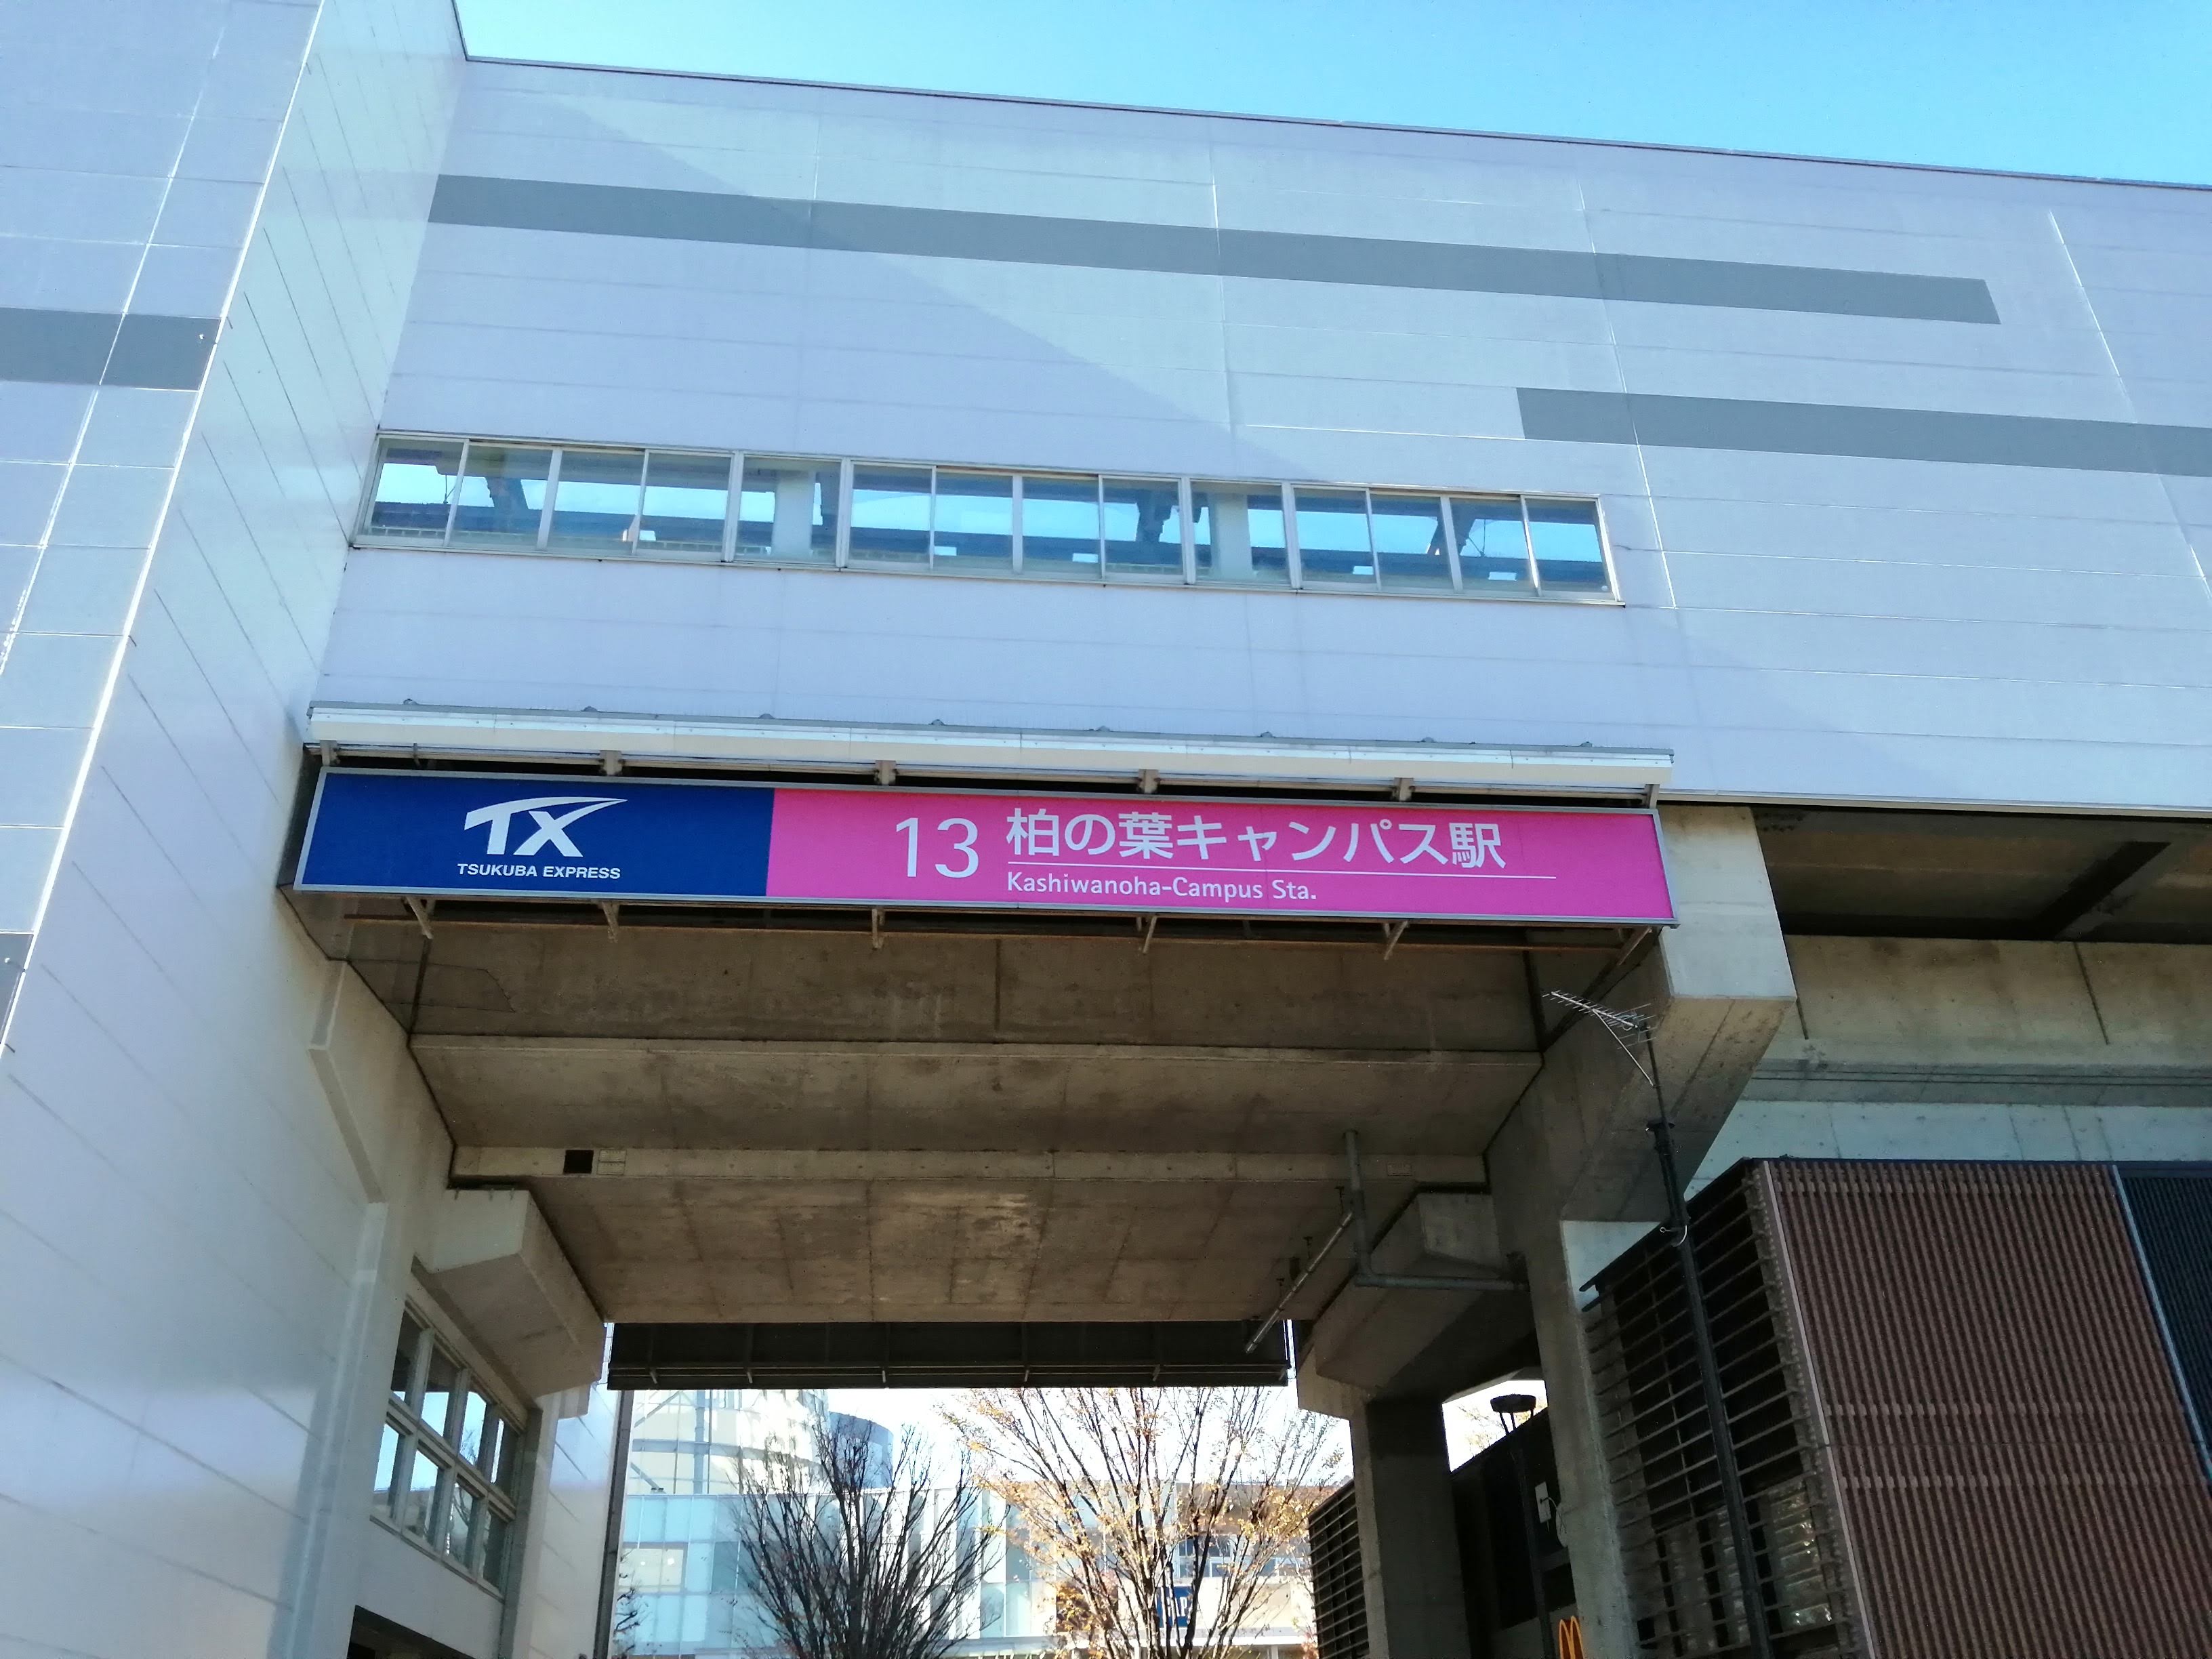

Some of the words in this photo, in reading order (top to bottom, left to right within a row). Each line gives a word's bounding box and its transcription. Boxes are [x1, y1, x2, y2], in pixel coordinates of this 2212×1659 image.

[464, 796, 628, 857] TX
[896, 817, 979, 878] 13
[1006, 808, 1506, 869] 柏の葉キャンパス駅
[457, 863, 538, 877] TSUKUBA
[543, 865, 621, 879] EXPRESS
[1008, 872, 1263, 903] Kashiwanoha-Campus
[1272, 879, 1317, 900] Sta.
